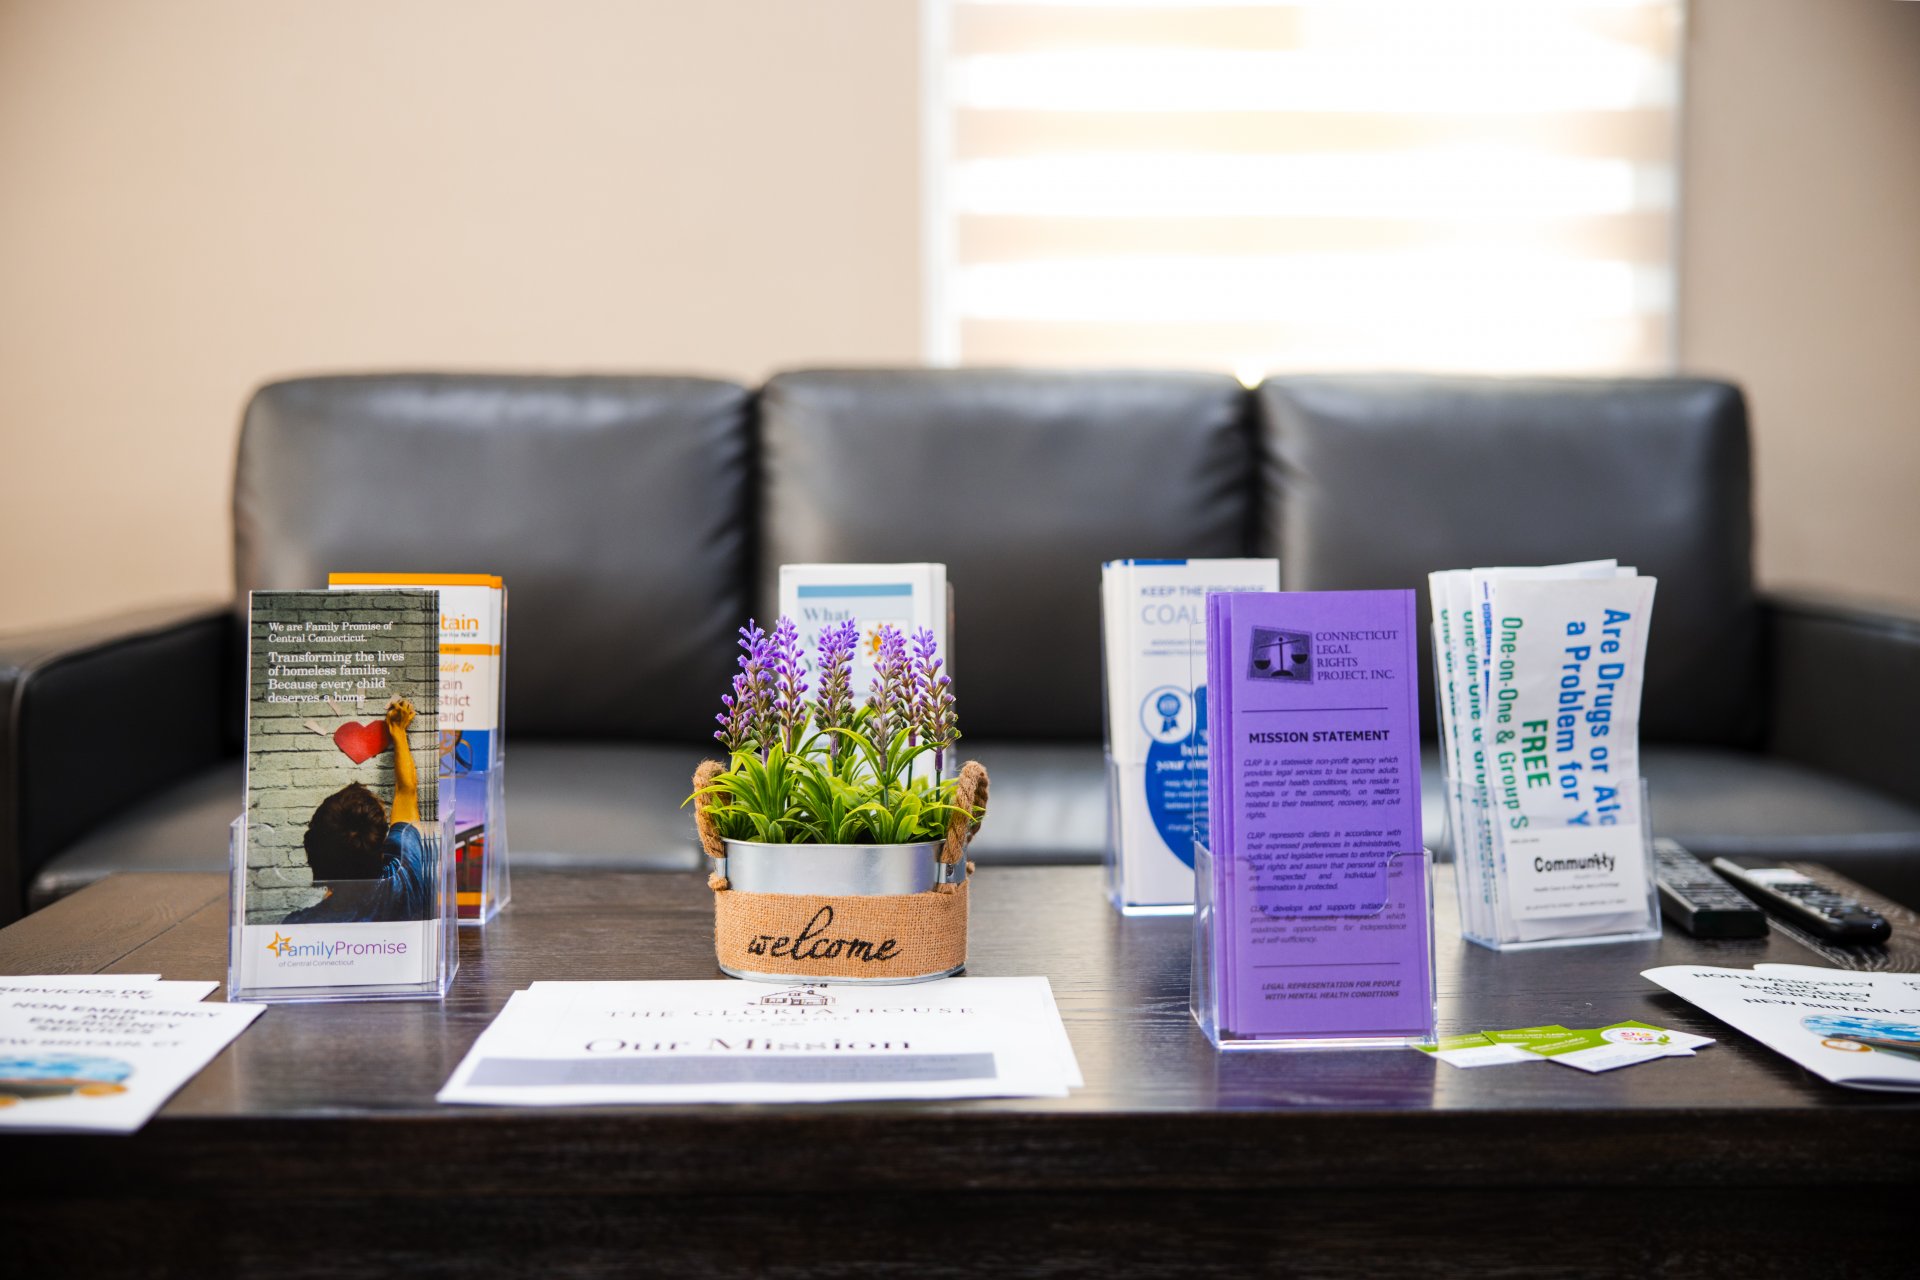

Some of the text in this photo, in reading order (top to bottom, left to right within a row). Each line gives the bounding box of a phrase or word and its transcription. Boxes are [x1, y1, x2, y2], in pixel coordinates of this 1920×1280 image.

[1141, 586, 1202, 597] KEEP THE
[1141, 604, 1202, 625] COAL
[269, 621, 392, 633] We are Family Promise of
[441, 614, 478, 630] tain
[1566, 621, 1586, 636] a
[269, 633, 367, 643] Central Connecticut.
[1316, 631, 1399, 642] CONNECTICUT
[1317, 645, 1351, 654] LEGAL
[268, 651, 404, 664] Transforming the lives
[1317, 657, 1358, 668] RIGHTS
[268, 666, 390, 676] of homeless families.
[1318, 670, 1395, 681] PROJECT, INC.
[268, 678, 385, 690] Because every child
[268, 693, 319, 703] deserves
[324, 694, 330, 702] a
[439, 696, 470, 706] strict
[1557, 645, 1591, 753] Problem
[1585, 609, 1631, 826] Are Drugs or Alc
[1249, 730, 1390, 744] MISSION STATEMENT
[1522, 719, 1551, 788] FREE
[1352, 757, 1375, 765] agency
[1262, 779, 1286, 787] mental
[1313, 778, 1348, 786] conditions,
[1498, 751, 1521, 810] Group
[1558, 761, 1582, 801] for
[1245, 790, 1275, 798] hospitals
[1534, 851, 1615, 872] Community
[748, 906, 903, 962] welcome
[278, 939, 406, 959] FamilyPromise
[1287, 981, 1353, 989] REPRESENTATION
[1265, 992, 1286, 1000] WITH
[1288, 992, 1317, 1000] MENTAL
[1320, 991, 1349, 999] HEALTH
[606, 1007, 976, 1018] THE GLORIA HOUSE
[585, 1037, 911, 1051] Our Mission
